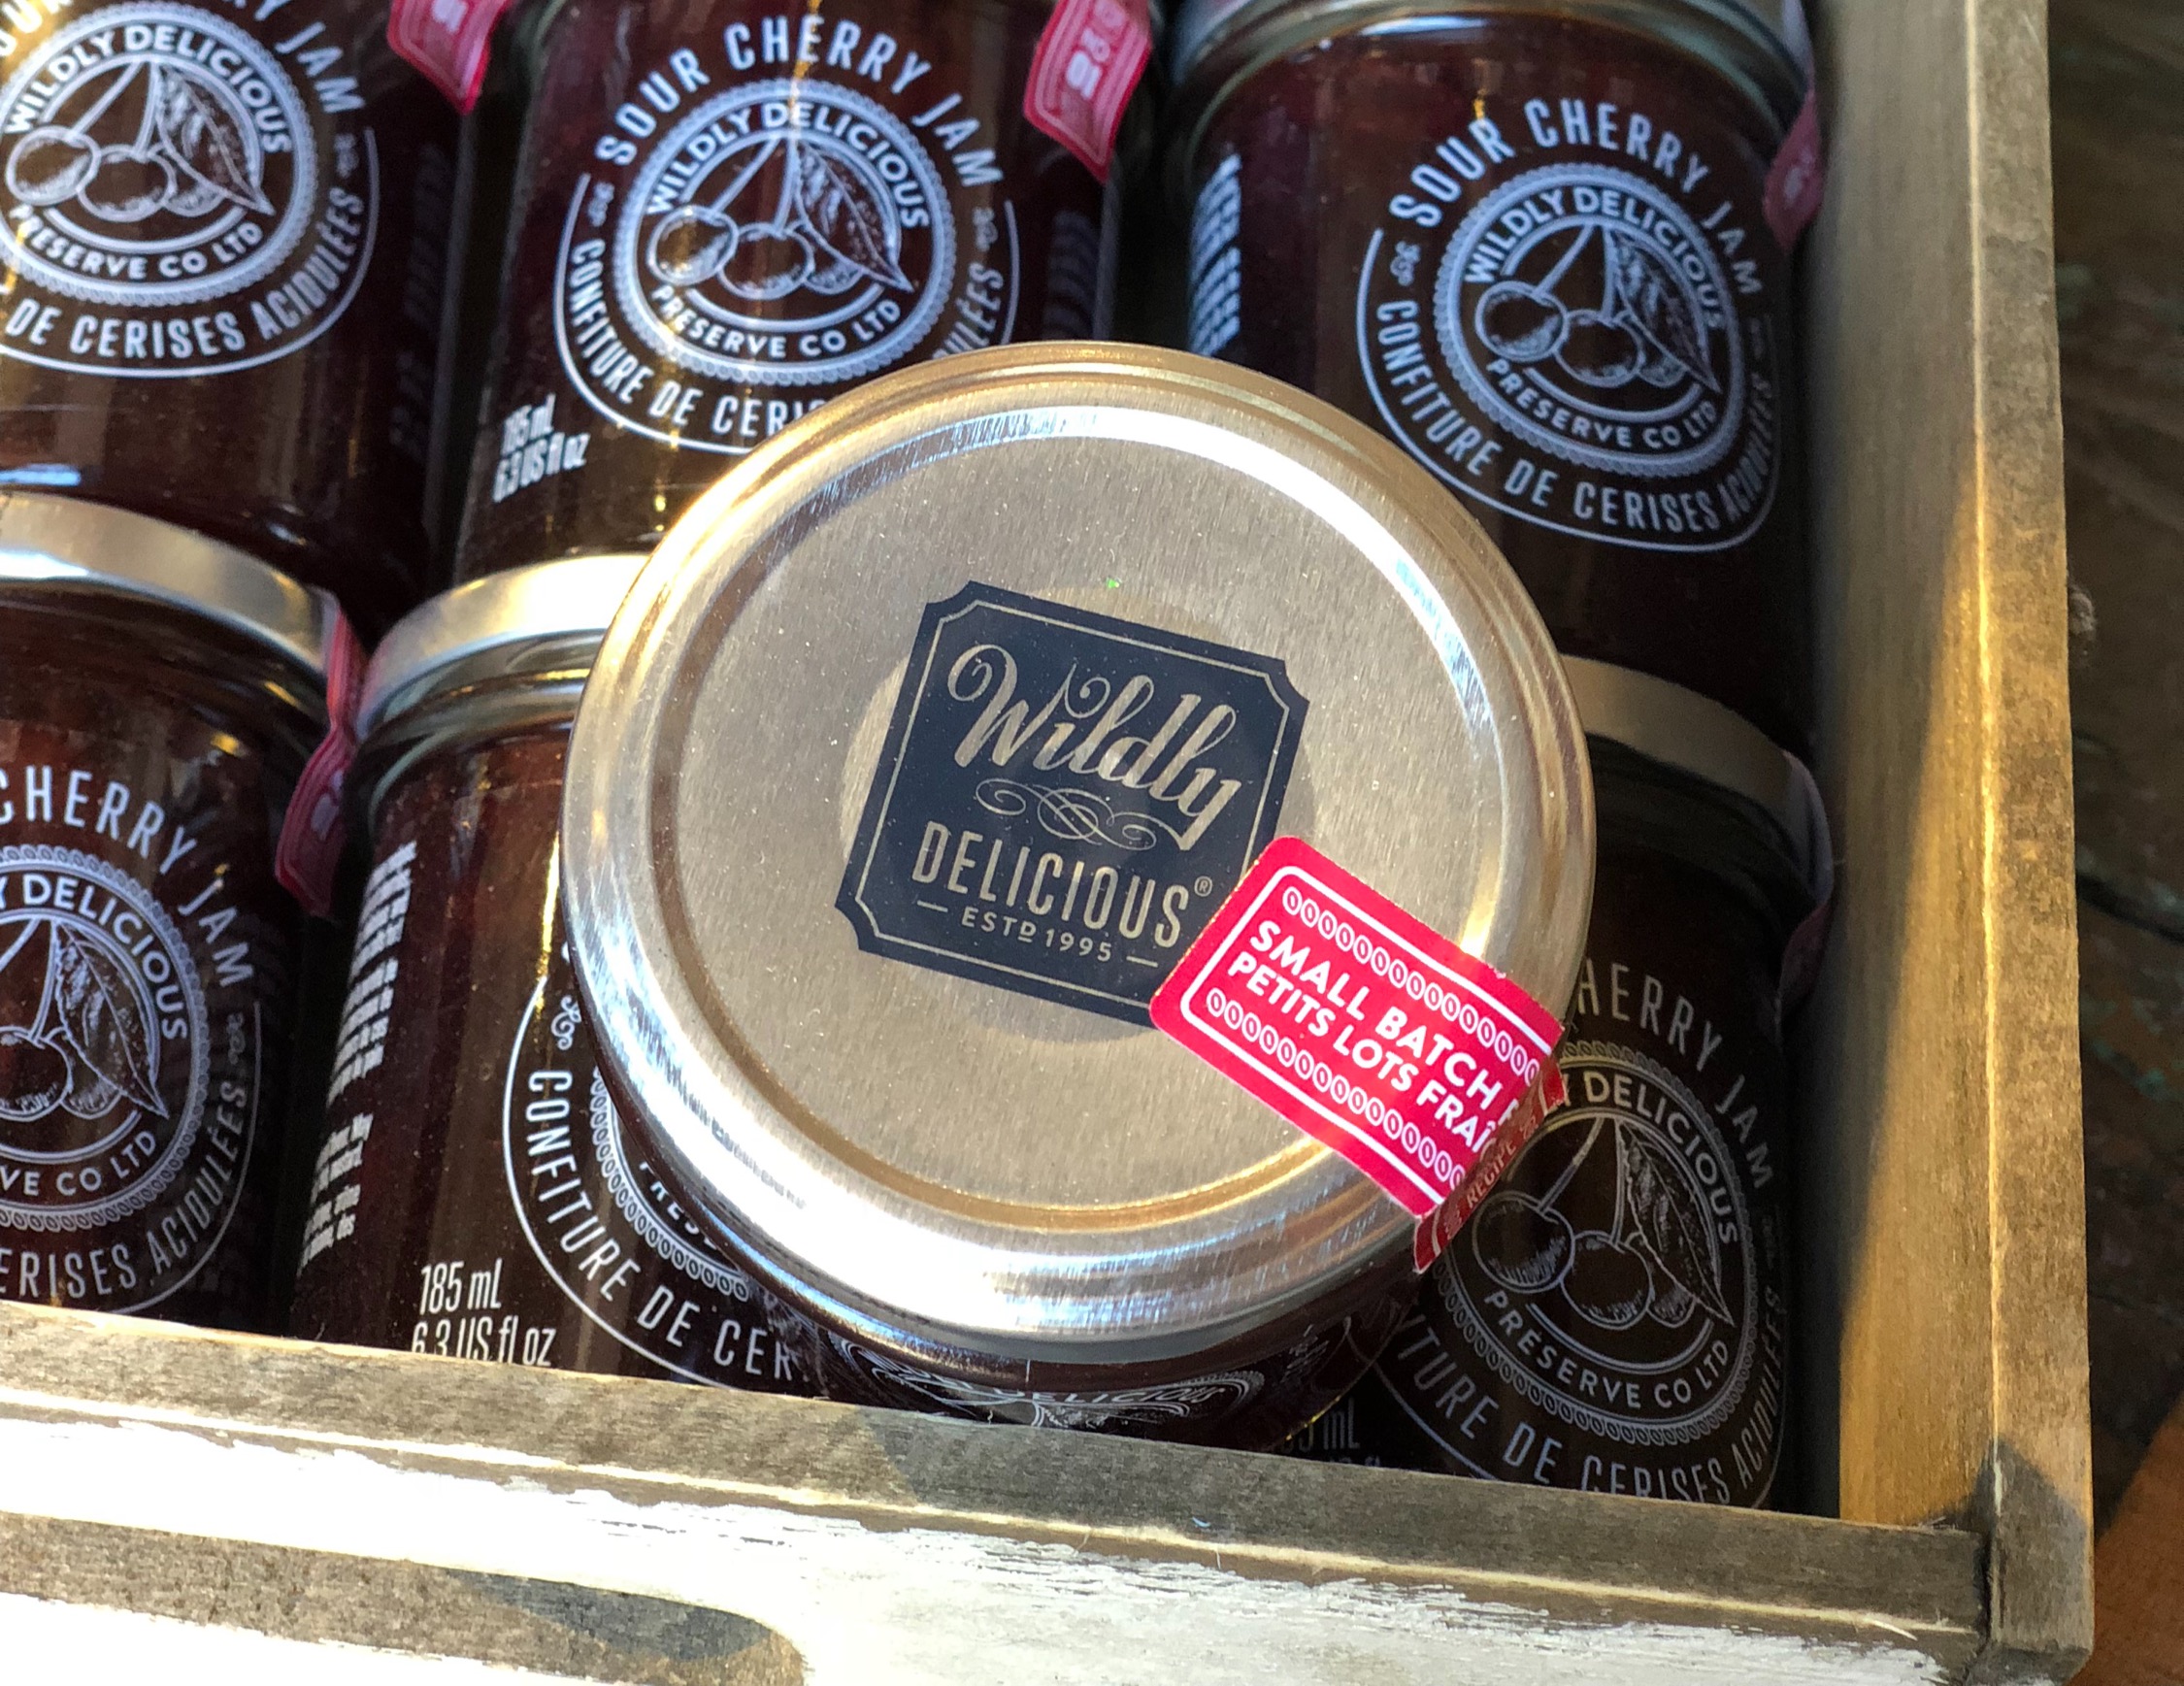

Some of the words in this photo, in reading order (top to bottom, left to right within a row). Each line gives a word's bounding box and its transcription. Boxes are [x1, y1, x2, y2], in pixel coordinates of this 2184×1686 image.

[3, 29, 116, 134] WILDLY
[123, 25, 292, 153] DELICIOUS
[274, 20, 366, 115] JAM
[596, 49, 711, 168] SOUR
[724, 16, 931, 95] CHERRY
[915, 93, 1004, 187] JAM
[645, 109, 751, 215] WILDLY
[760, 101, 930, 229] DELICIOUS
[1389, 117, 1516, 229] SOUR
[1525, 99, 1711, 194] CHERRY
[1702, 200, 1762, 296] JAM
[9, 204, 147, 280] PRESERVE
[158, 249, 207, 280] CO
[215, 221, 265, 265] LTD
[1462, 188, 1564, 284] WILDLY
[1572, 186, 1726, 331] DELICIOUS
[5, 297, 62, 346] DE
[69, 318, 247, 359] CERISES
[571, 240, 651, 406] CONFITURE
[647, 380, 705, 434] DE
[650, 284, 787, 357] PRESERVE
[798, 326, 846, 356] CO
[852, 299, 902, 341] LTD
[1376, 300, 1499, 478] CONFITURE
[1505, 457, 1559, 509] DE
[1572, 482, 1721, 533] CERISES
[1486, 360, 1634, 448] PRESERVE
[1641, 423, 1681, 449] CO
[1685, 399, 1720, 441] LTD
[947, 644, 1242, 852] Wildly
[22, 875, 188, 1041] DELICIOUS
[178, 877, 255, 988] JAM
[1045, 926, 1112, 963] 1995
[1226, 951, 1338, 1039] PETITS
[1332, 1028, 1421, 1093] LOTS
[1249, 919, 1368, 1020] SMALL
[1376, 1008, 1504, 1111] BATCH
[1577, 958, 1723, 1073] HERRY
[1714, 1074, 1774, 1189] JAM
[0, 1242, 138, 1300] ERISES
[146, 1083, 247, 1276] ACIDULÉES
[55, 1167, 103, 1197] CO
[110, 1130, 157, 1179] LTD
[525, 1070, 641, 1302] CONFITURE
[637, 1284, 700, 1347] DE
[1582, 1070, 1739, 1244] DELICIOUS
[418, 1261, 465, 1316] 185
[467, 1257, 503, 1310] mL
[456, 1315, 494, 1362] US
[498, 1314, 519, 1364] fl
[521, 1326, 557, 1367] oz
[1484, 1290, 1641, 1409] PRESERVE
[1654, 1381, 1693, 1408] CO
[1696, 1339, 1729, 1391] LTD
[1502, 1427, 1562, 1483] DE
